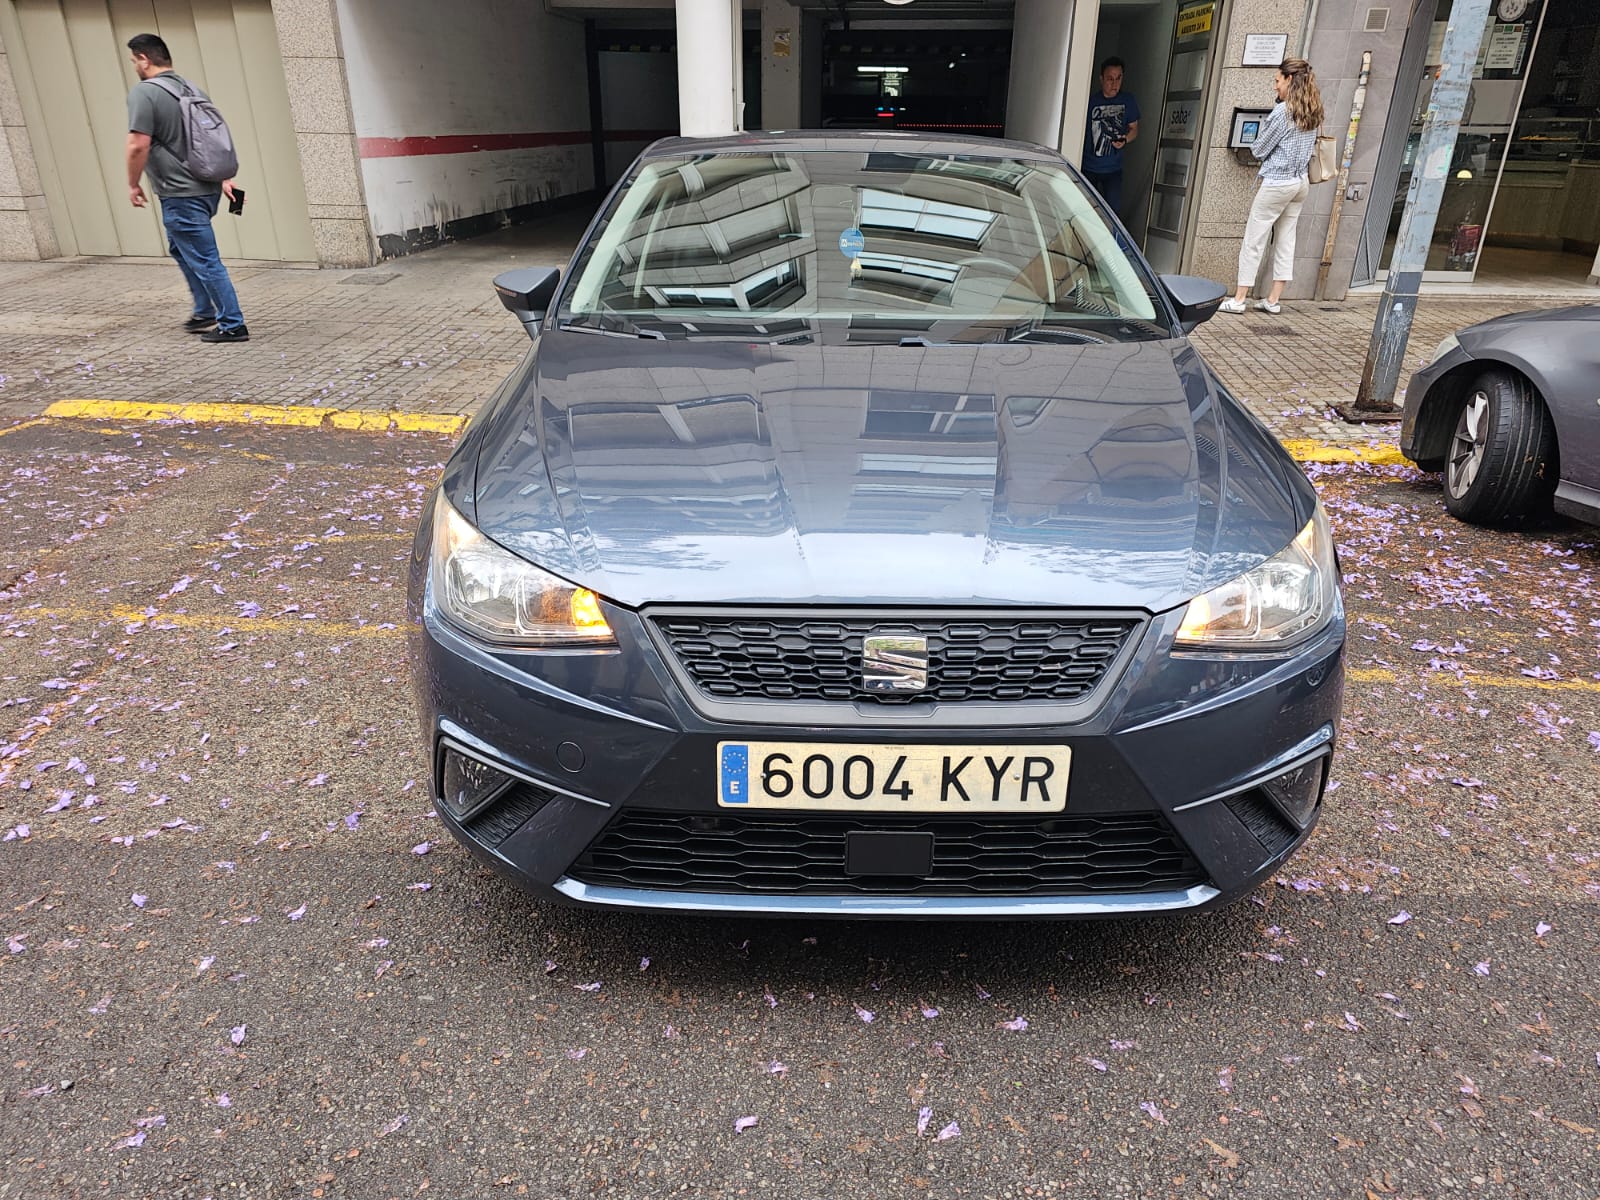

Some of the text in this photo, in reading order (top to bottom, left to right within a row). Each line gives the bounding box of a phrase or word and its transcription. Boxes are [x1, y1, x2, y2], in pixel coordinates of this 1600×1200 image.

[729, 781, 740, 795] E
[761, 752, 1055, 802] 6004 KYR
